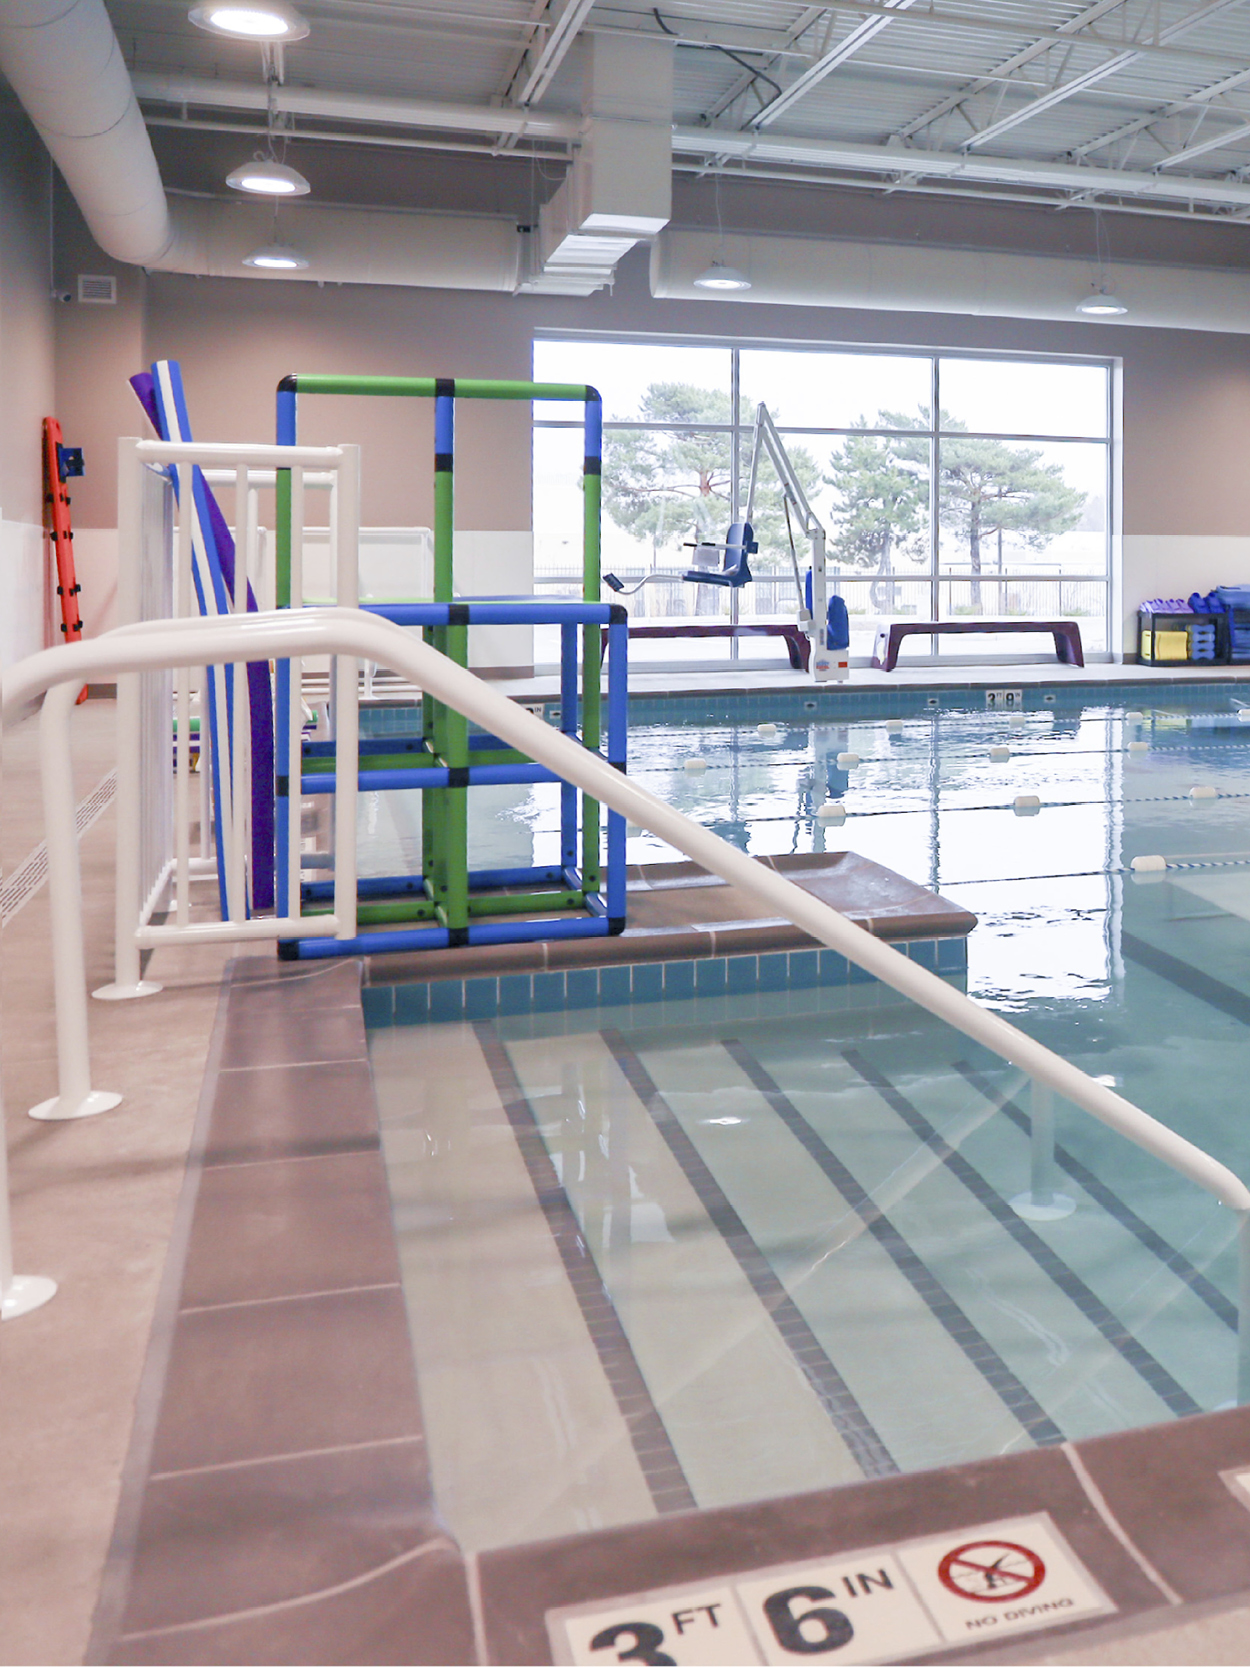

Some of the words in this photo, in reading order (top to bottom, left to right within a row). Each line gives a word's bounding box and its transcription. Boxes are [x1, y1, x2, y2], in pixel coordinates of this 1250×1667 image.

[671, 1603, 721, 1635] FT
[762, 1586, 854, 1656] 6
[841, 1568, 895, 1598] IN
[965, 1617, 998, 1631] NO
[1003, 1598, 1075, 1622] DIVING
